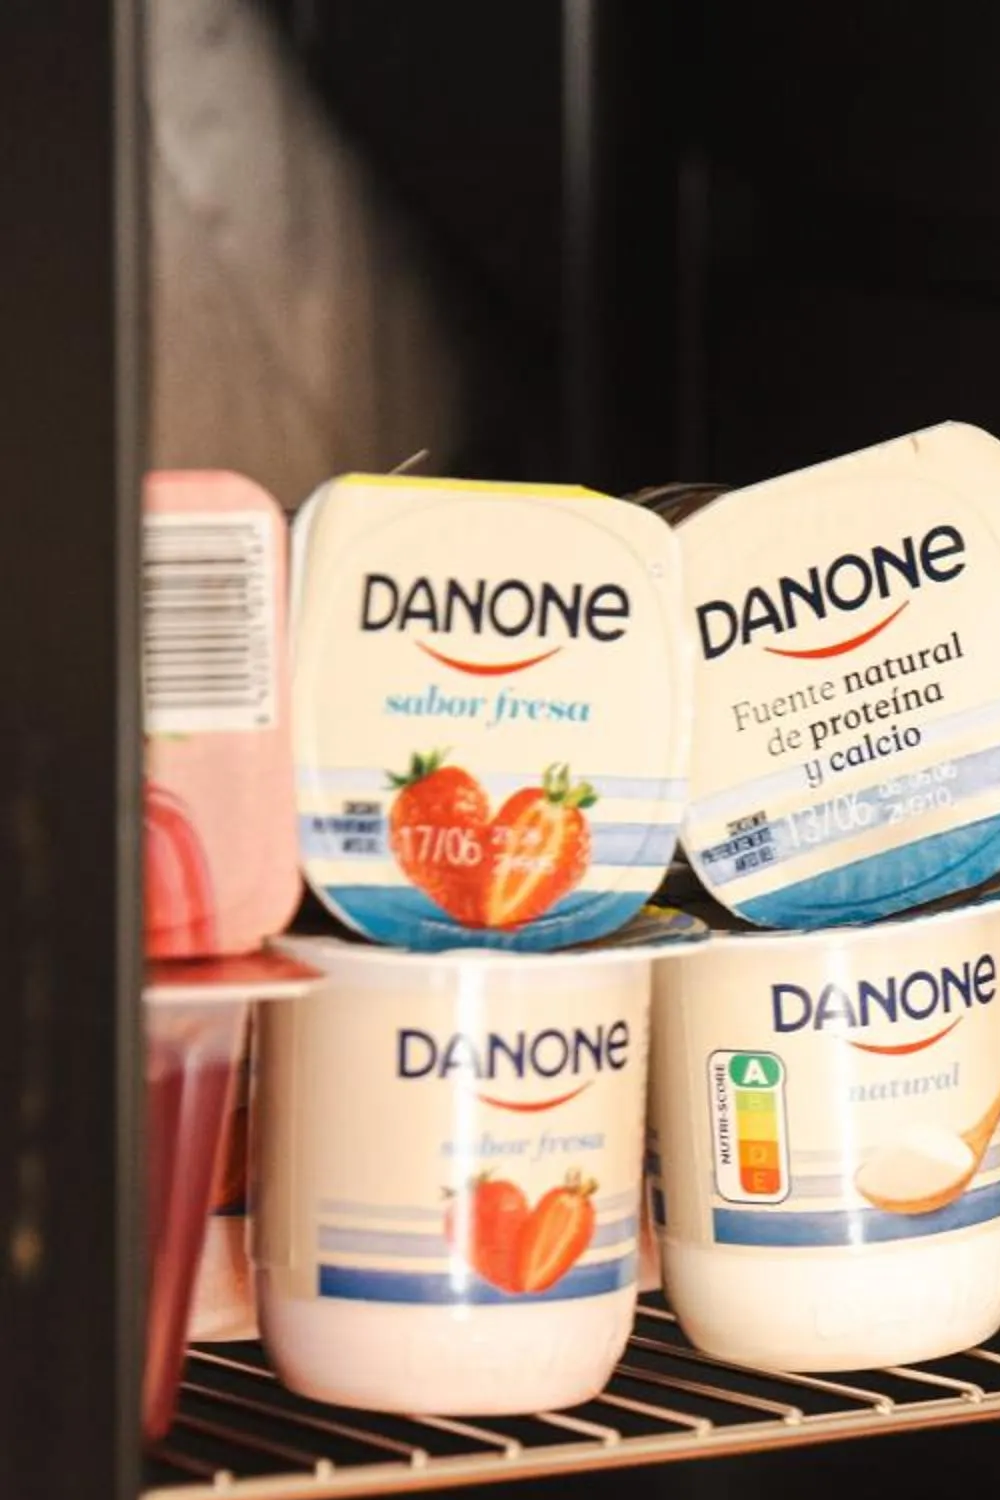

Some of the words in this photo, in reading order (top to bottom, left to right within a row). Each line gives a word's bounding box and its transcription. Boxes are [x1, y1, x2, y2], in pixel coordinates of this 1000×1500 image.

[385, 685, 487, 721] sabor
[485, 690, 592, 730] fresa
[731, 679, 836, 732] Fuente
[842, 631, 964, 695] natural
[766, 724, 804, 758] de
[808, 680, 945, 750] proteína
[803, 759, 824, 789] y
[828, 723, 923, 772] calcio
[742, 1058, 769, 1085] A
[848, 1062, 961, 1103] natural
[714, 1063, 731, 1166] NUTRI-SCORE
[440, 1130, 531, 1158] sbor
